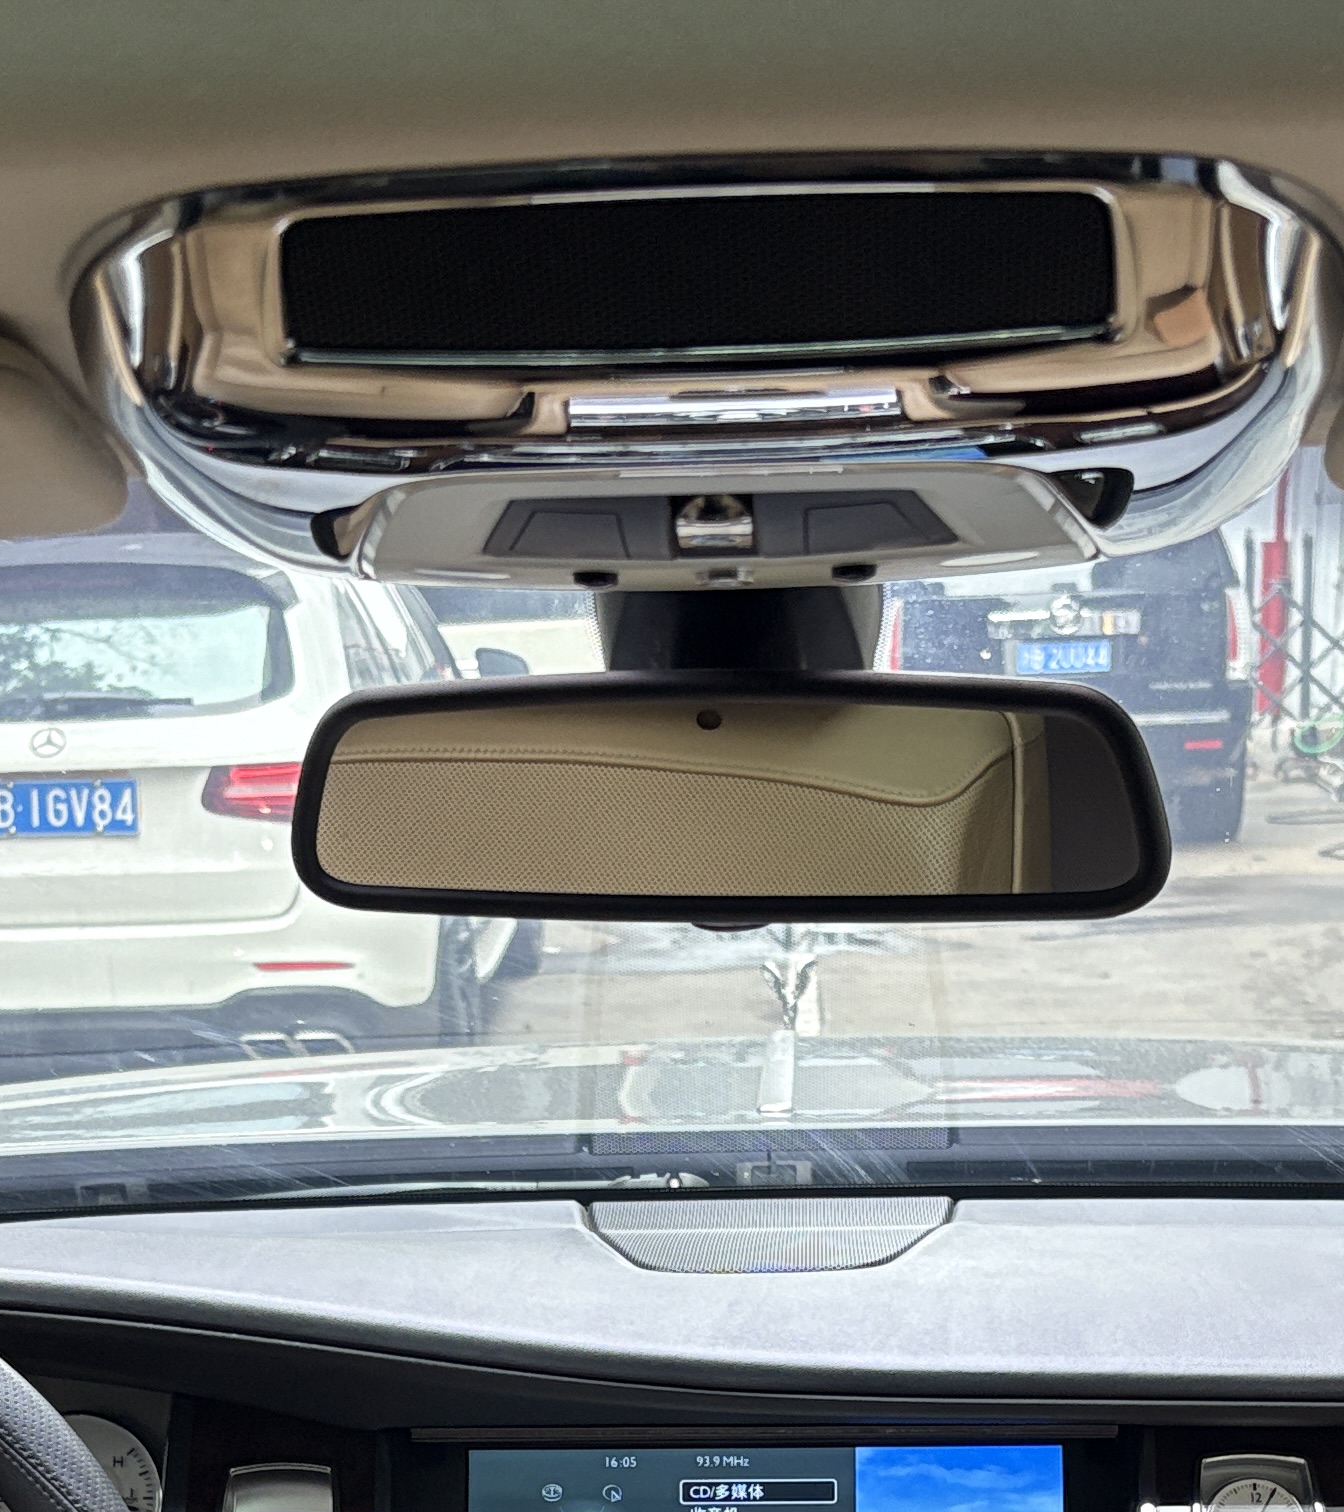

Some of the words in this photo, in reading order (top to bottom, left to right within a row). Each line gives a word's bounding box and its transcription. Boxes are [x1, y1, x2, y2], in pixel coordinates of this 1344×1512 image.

[112, 1455, 124, 1468] H
[605, 1456, 637, 1468] 16:05
[696, 1456, 720, 1468] 93.9
[722, 1456, 750, 1467] MHz
[689, 1484, 765, 1501] CD/多媒体
[1250, 1492, 1263, 1504] 12
